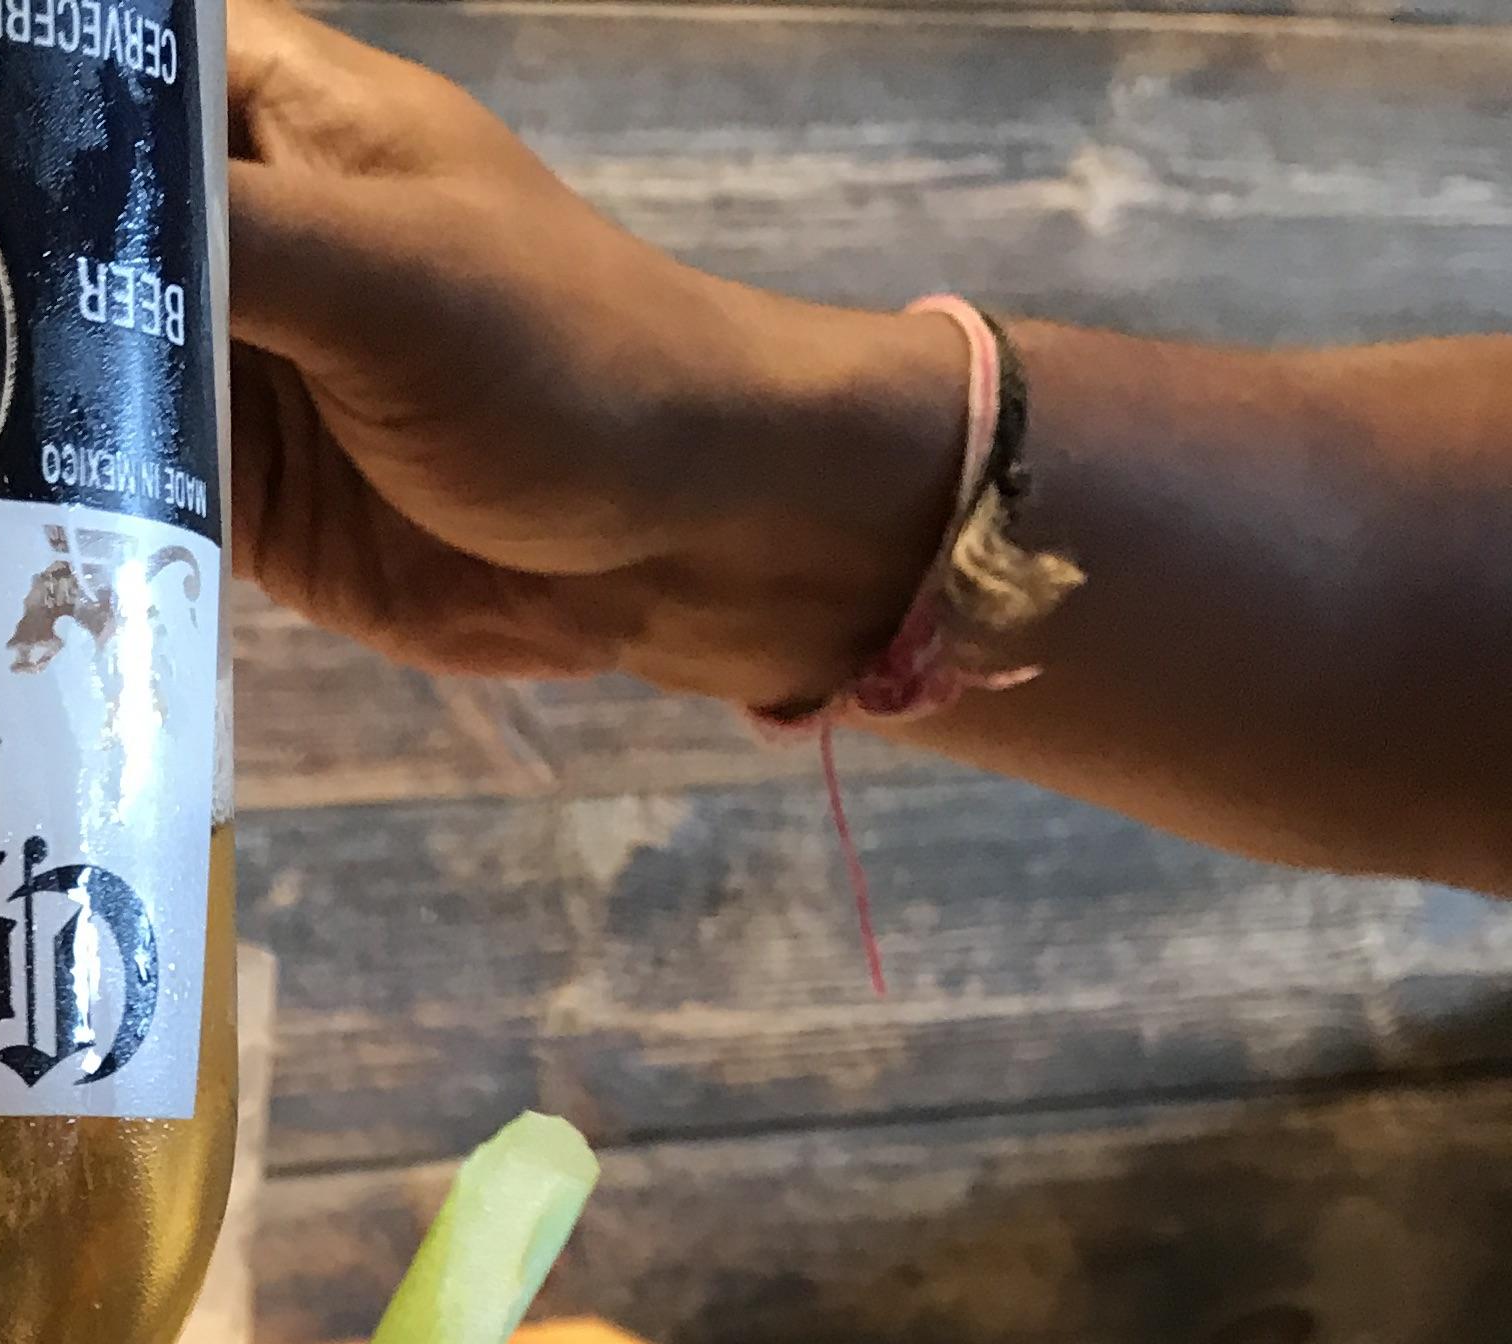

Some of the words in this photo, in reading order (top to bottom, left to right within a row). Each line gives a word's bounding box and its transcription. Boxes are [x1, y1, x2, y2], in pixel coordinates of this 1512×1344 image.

[76, 256, 185, 347] BEER
[41, 444, 136, 495] MEXICO
[140, 462, 160, 499] IN
[164, 467, 207, 519] MADE
